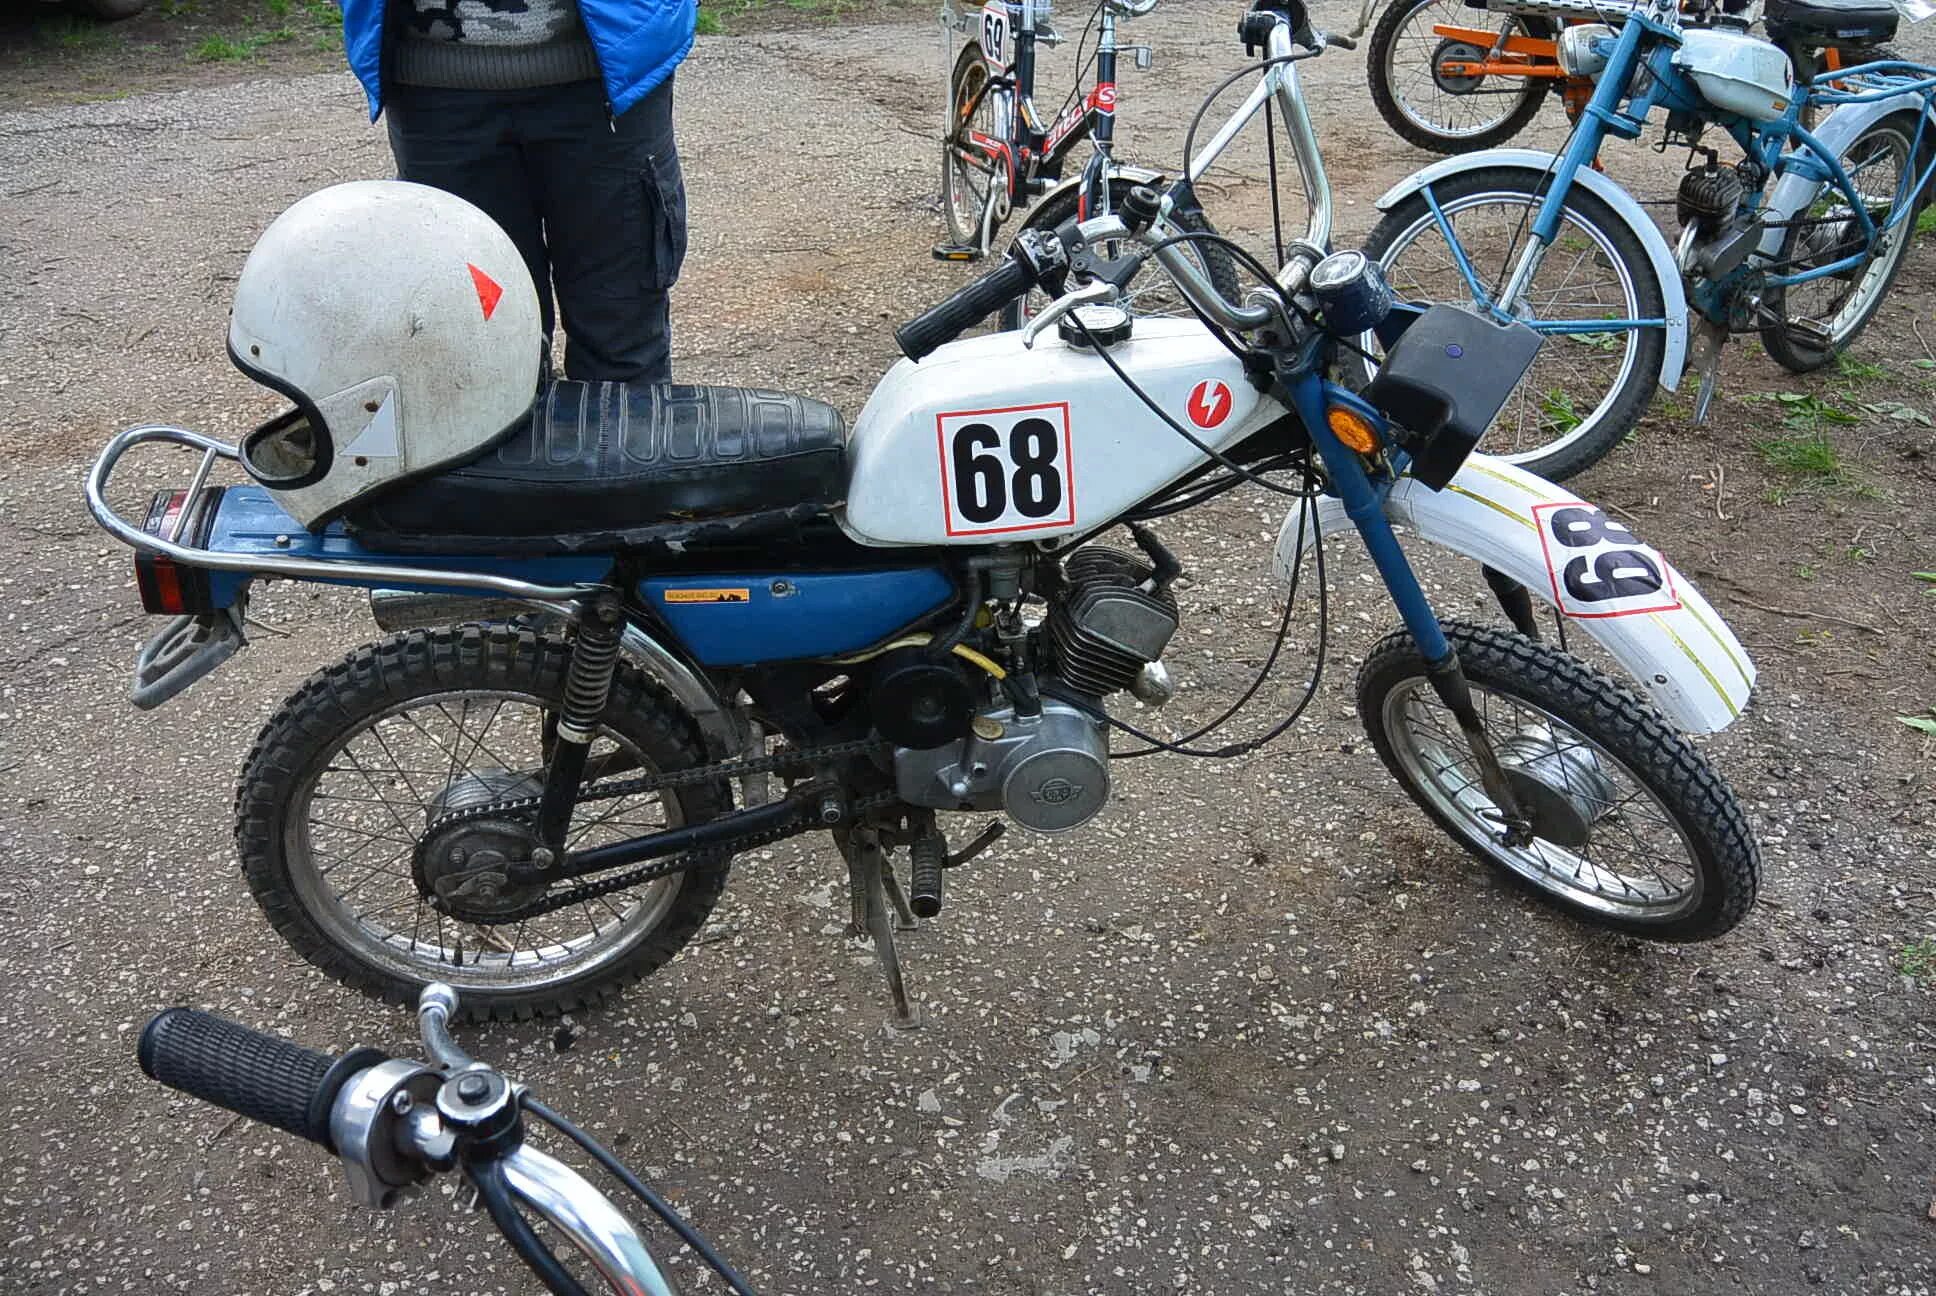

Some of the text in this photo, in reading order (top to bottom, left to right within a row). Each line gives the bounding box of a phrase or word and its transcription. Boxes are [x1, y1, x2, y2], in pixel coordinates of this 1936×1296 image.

[985, 14, 1003, 62] 69
[952, 418, 1062, 523] 68
[1551, 508, 1663, 603] 68
